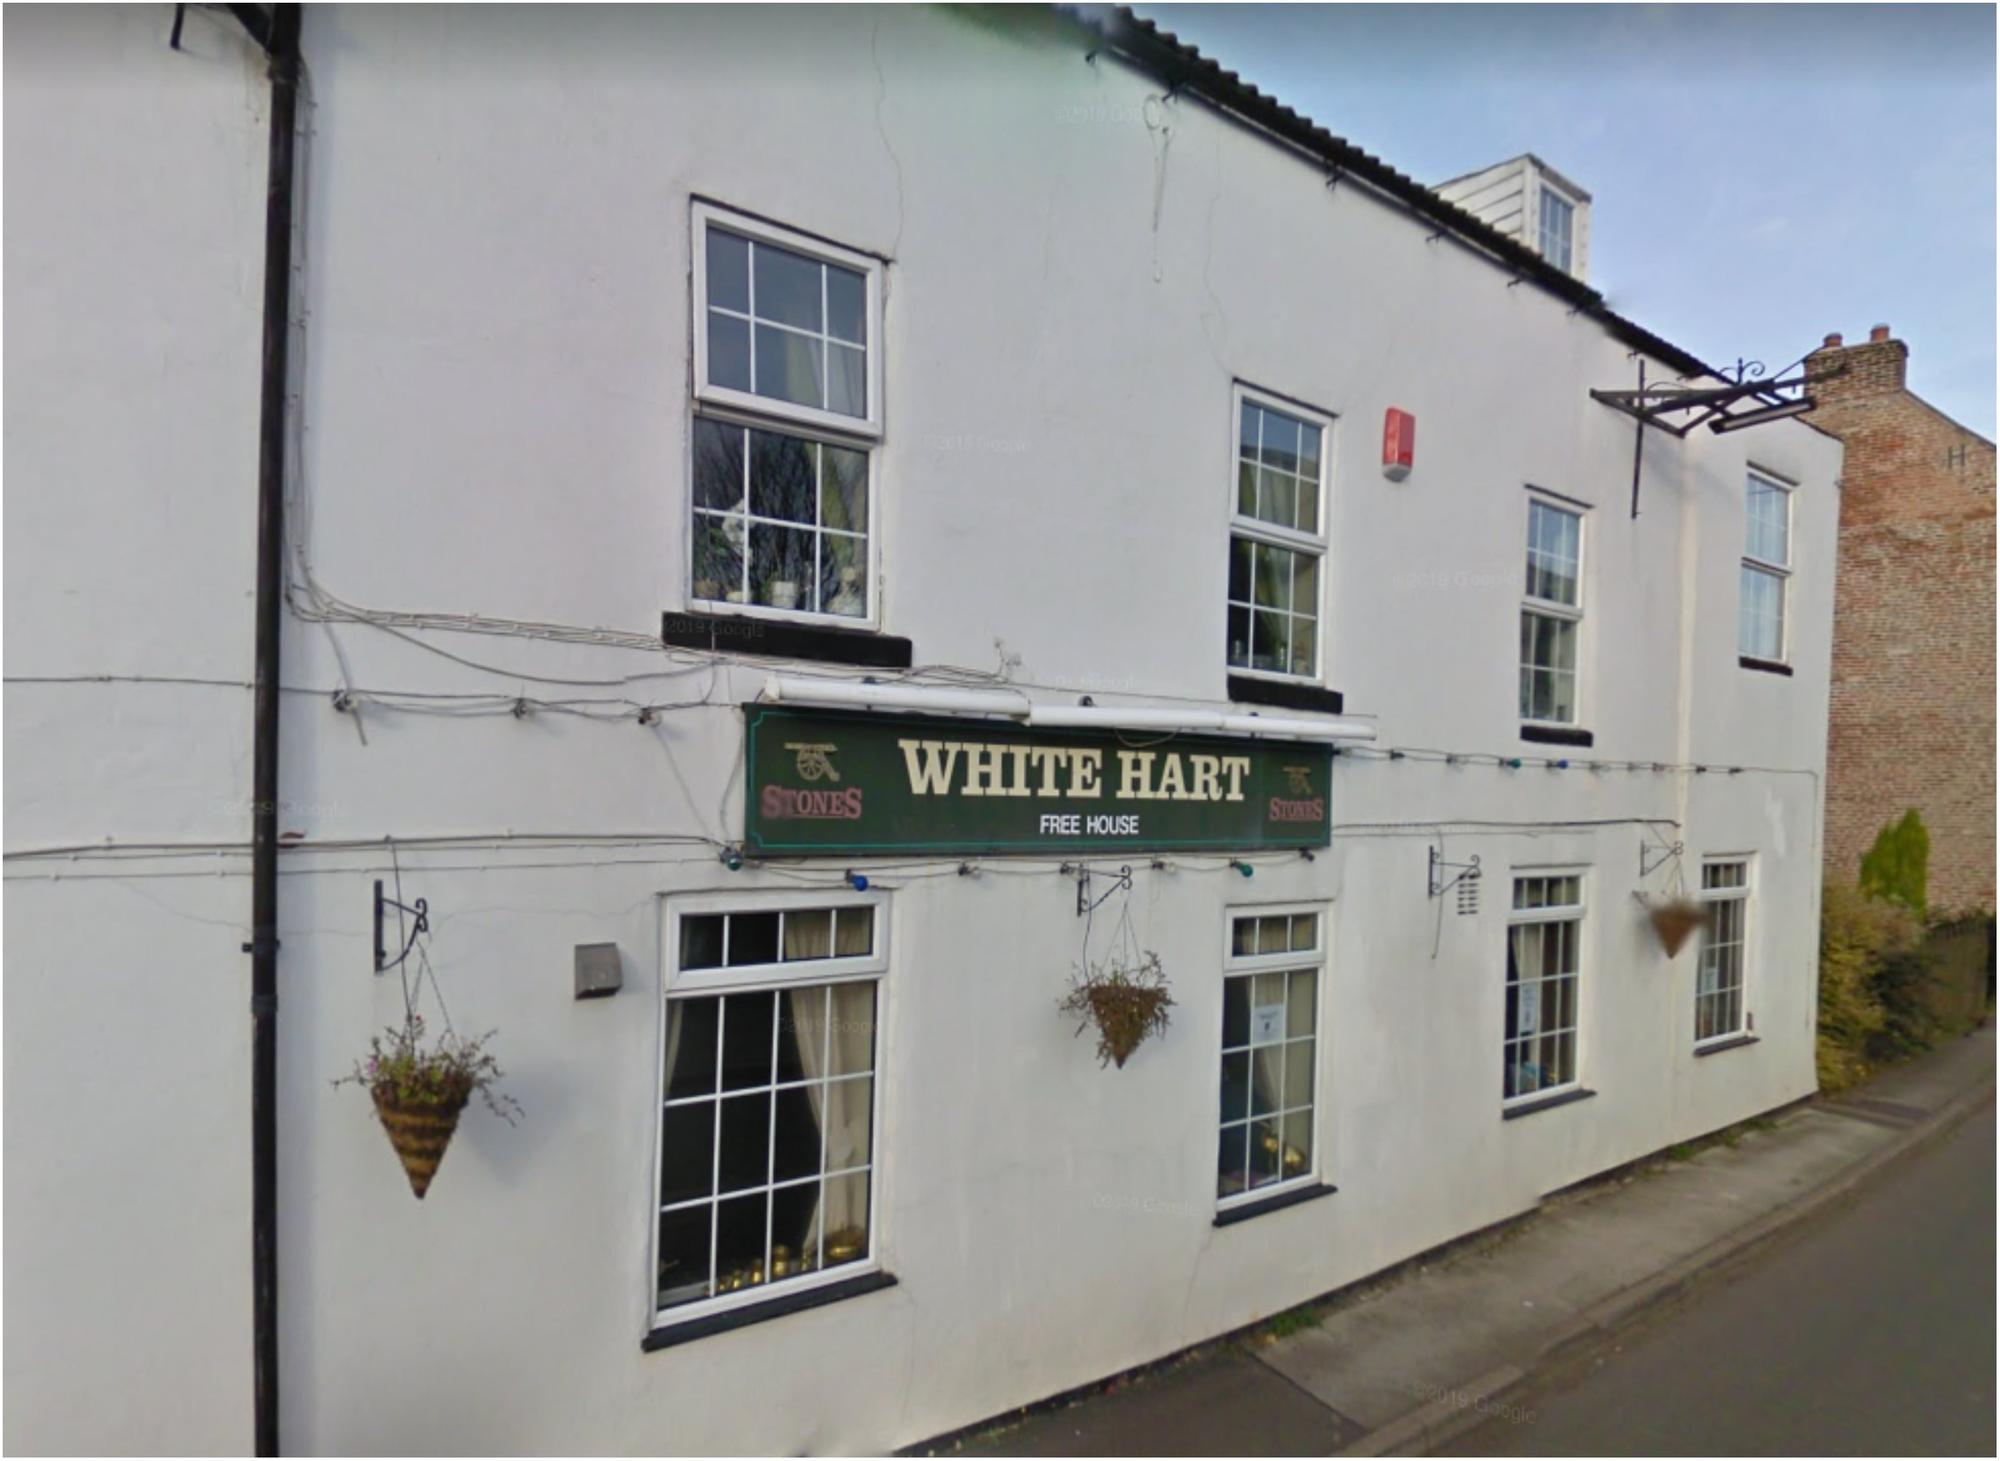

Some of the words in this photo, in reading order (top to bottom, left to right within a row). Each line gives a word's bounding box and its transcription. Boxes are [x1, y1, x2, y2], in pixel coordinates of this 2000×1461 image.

[898, 738, 1102, 798] WHITE
[1116, 750, 1250, 802] HART
[762, 784, 863, 819] STONES
[1268, 796, 1325, 822] STONES
[1040, 814, 1081, 835] FREE
[1086, 815, 1139, 835] HOUSE
